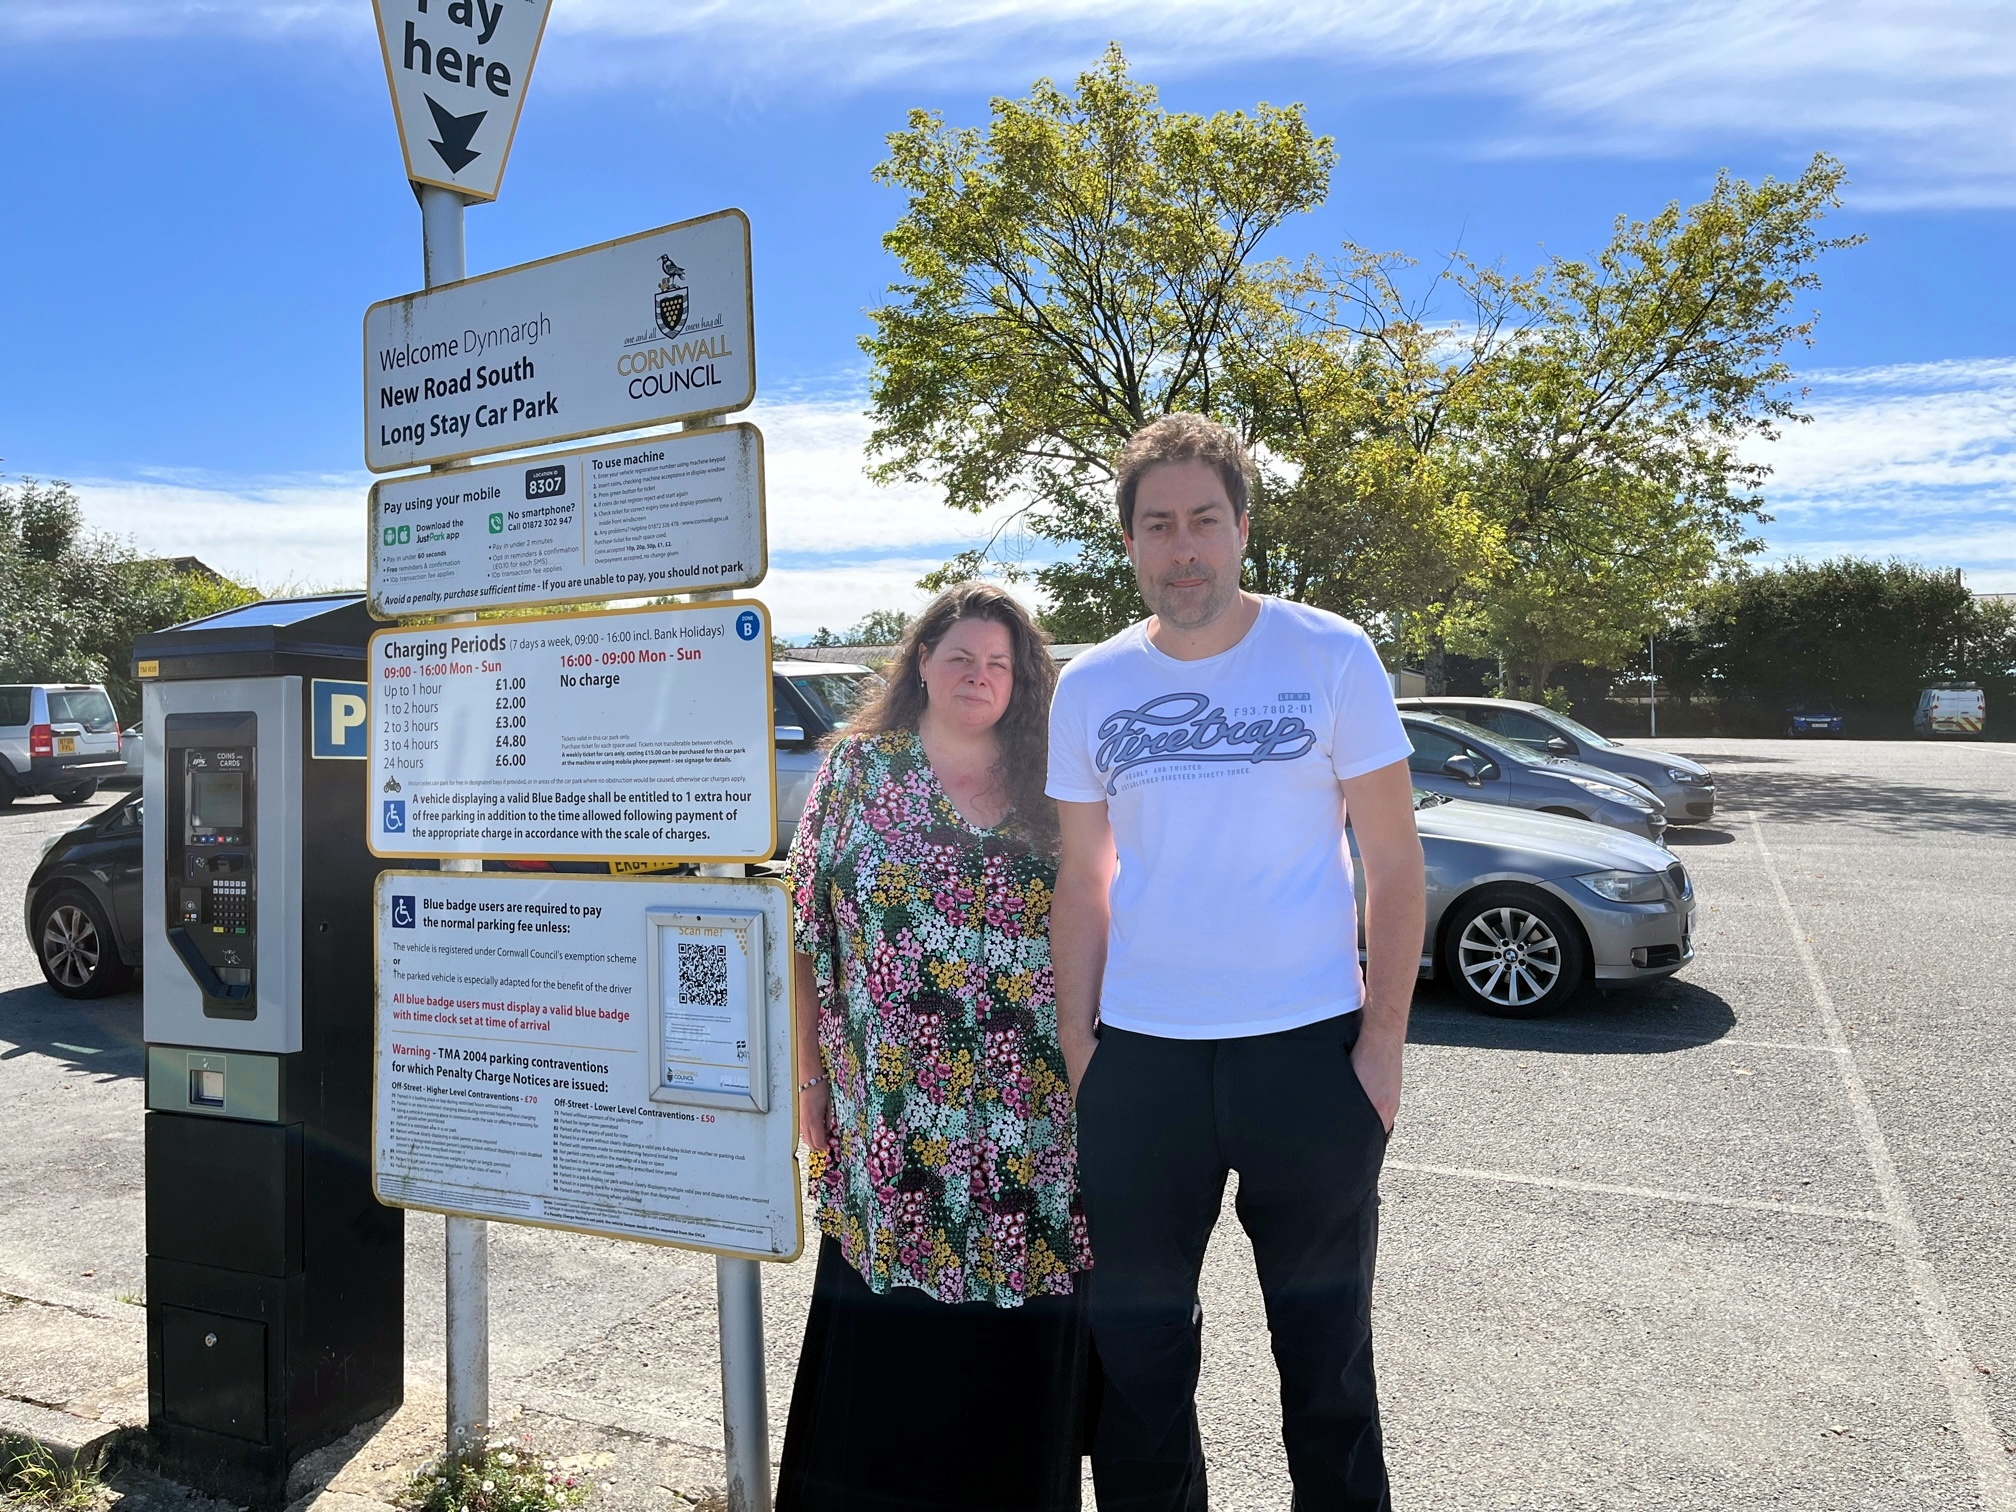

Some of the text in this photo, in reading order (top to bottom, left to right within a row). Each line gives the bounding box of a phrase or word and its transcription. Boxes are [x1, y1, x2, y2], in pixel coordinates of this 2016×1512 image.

[404, 20, 511, 97] here
[379, 312, 551, 371] Welcome Dynnargh
[635, 329, 648, 342] and
[648, 328, 657, 339] all
[617, 335, 732, 376] CORNWALL
[381, 358, 534, 408] New Road South
[629, 364, 721, 399] COUNCIL
[381, 393, 558, 446] Long Stay Car Park
[592, 450, 664, 470] To use machine
[530, 477, 561, 494] 8307
[384, 486, 500, 514] Pay using your mobile
[508, 502, 575, 520] No smartphone?
[416, 519, 463, 532] Download the
[508, 516, 572, 531] Call 01872 302 947
[416, 531, 459, 543] JustPark app
[384, 594, 405, 605] Avoid
[412, 591, 442, 604] penalty,
[443, 588, 478, 601] purchase
[480, 584, 516, 596] sufficient
[518, 582, 536, 592] time
[542, 579, 548, 589] If
[550, 580, 566, 591] you
[567, 579, 581, 587] are
[583, 574, 614, 585] unable
[616, 574, 625, 582] to
[627, 572, 646, 584] pay,
[648, 570, 665, 582] you
[667, 565, 699, 578] should
[702, 564, 718, 574] not
[720, 561, 743, 575] park
[744, 623, 752, 636] B
[384, 639, 447, 661] Charging
[451, 633, 506, 654] Periods
[510, 639, 517, 650] (7
[519, 638, 538, 651] days
[547, 635, 572, 646] week,
[574, 633, 598, 645] 09:00
[607, 631, 631, 642] 16:00
[633, 629, 652, 641] incl.
[654, 627, 677, 639] Bank
[680, 624, 724, 639] Holidays)
[560, 653, 592, 667] 16:00
[602, 650, 635, 665] 09:00
[638, 649, 666, 662] Mon
[677, 647, 701, 660] Sun
[384, 666, 411, 678] 09:00
[420, 663, 447, 676] 16:00
[449, 662, 472, 674] Mon
[481, 660, 501, 672] Sun
[384, 678, 526, 699] Up to 1 hour £1.00
[560, 672, 620, 688] No charge
[385, 697, 526, 714] 1 to 2 hours £2.00
[331, 694, 366, 745] P
[384, 716, 526, 733] 2 to 3 hours £3.00
[384, 735, 526, 751] 3 to 4 hours £4.80
[1096, 692, 1316, 796] Firetrap
[384, 754, 526, 769] 24 hours £6.00
[412, 793, 418, 803] A
[420, 793, 450, 803] vehicle
[452, 792, 497, 806] displaying
[507, 792, 529, 803] valid
[532, 792, 552, 803] Blue
[555, 791, 586, 805] Badge
[588, 791, 611, 802] shall
[613, 791, 626, 802] be
[628, 790, 669, 802] entitled
[671, 792, 682, 802] to
[686, 791, 690, 802] 1
[694, 792, 722, 802] extra
[725, 790, 751, 801] hour
[423, 898, 602, 918] Blue badge users are required to pay
[423, 916, 570, 933] the normal parking fee unless:
[679, 926, 723, 936] Scan me!
